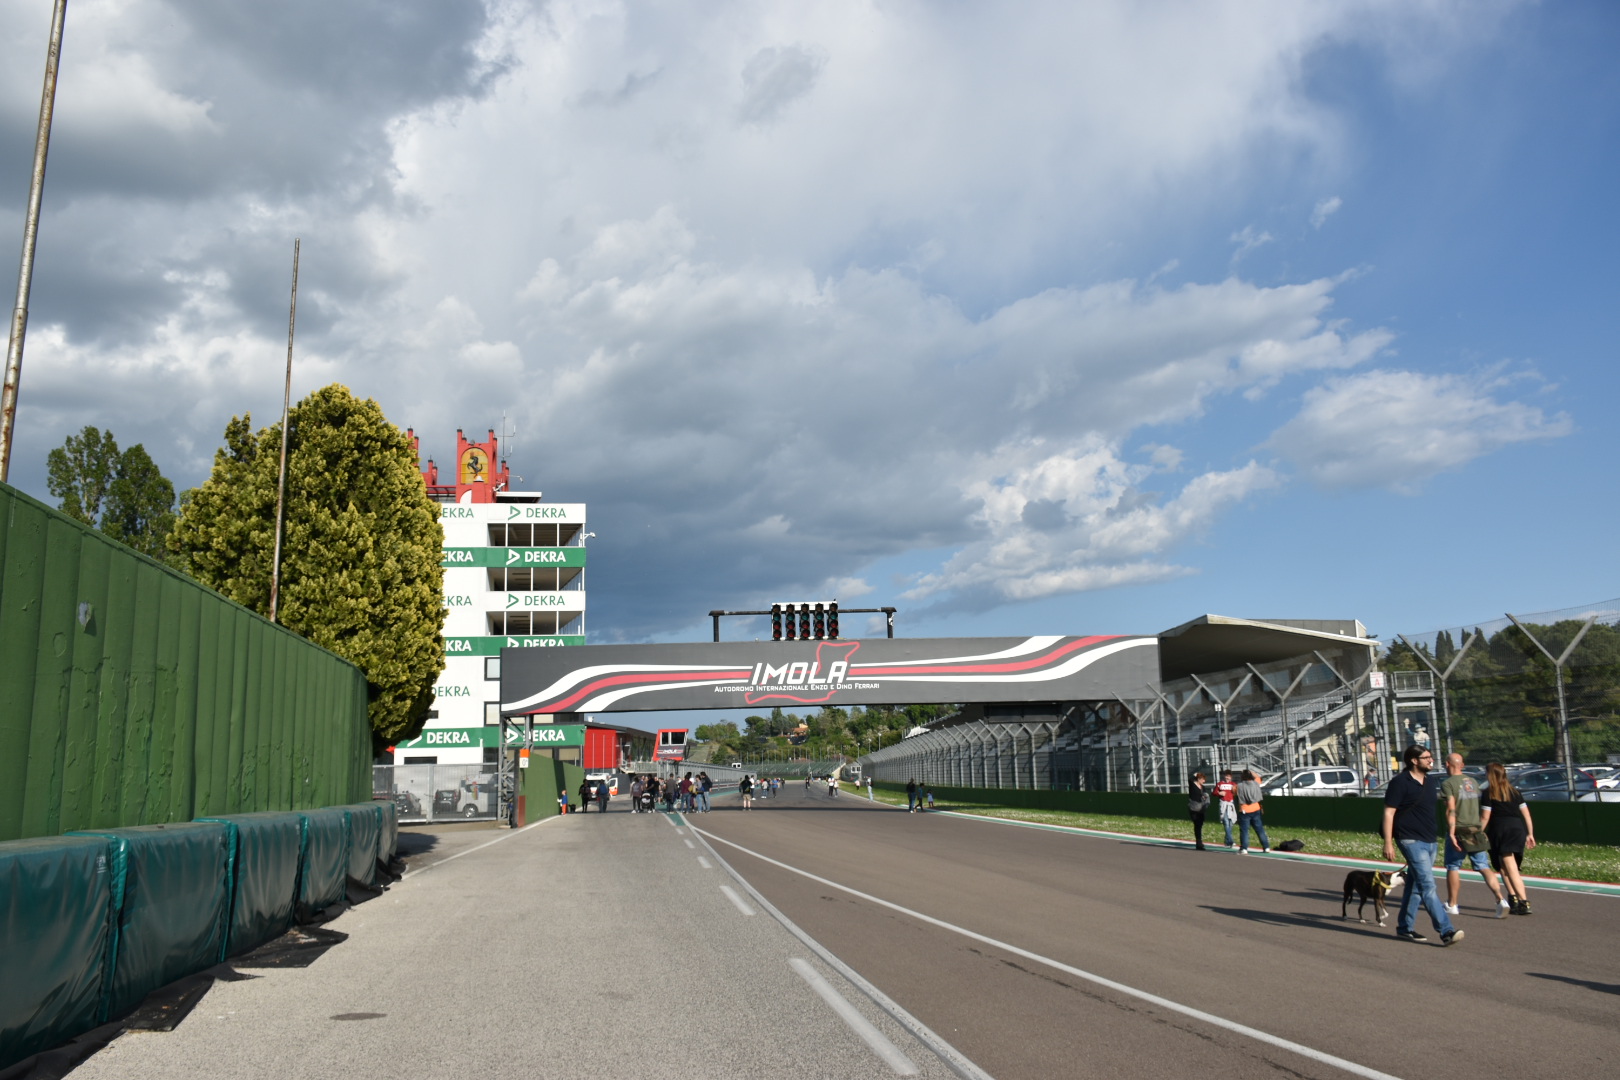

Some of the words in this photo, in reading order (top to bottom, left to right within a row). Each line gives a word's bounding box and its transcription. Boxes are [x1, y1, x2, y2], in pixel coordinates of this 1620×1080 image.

[442, 507, 474, 518] EKRA
[526, 508, 566, 518] DEKRA
[441, 550, 474, 562] EKRA
[524, 551, 566, 562] DEKRA
[524, 595, 565, 606] DEKRA
[445, 640, 472, 651] KRA
[751, 660, 848, 685] IMOLA
[426, 731, 470, 744] DEKRA
